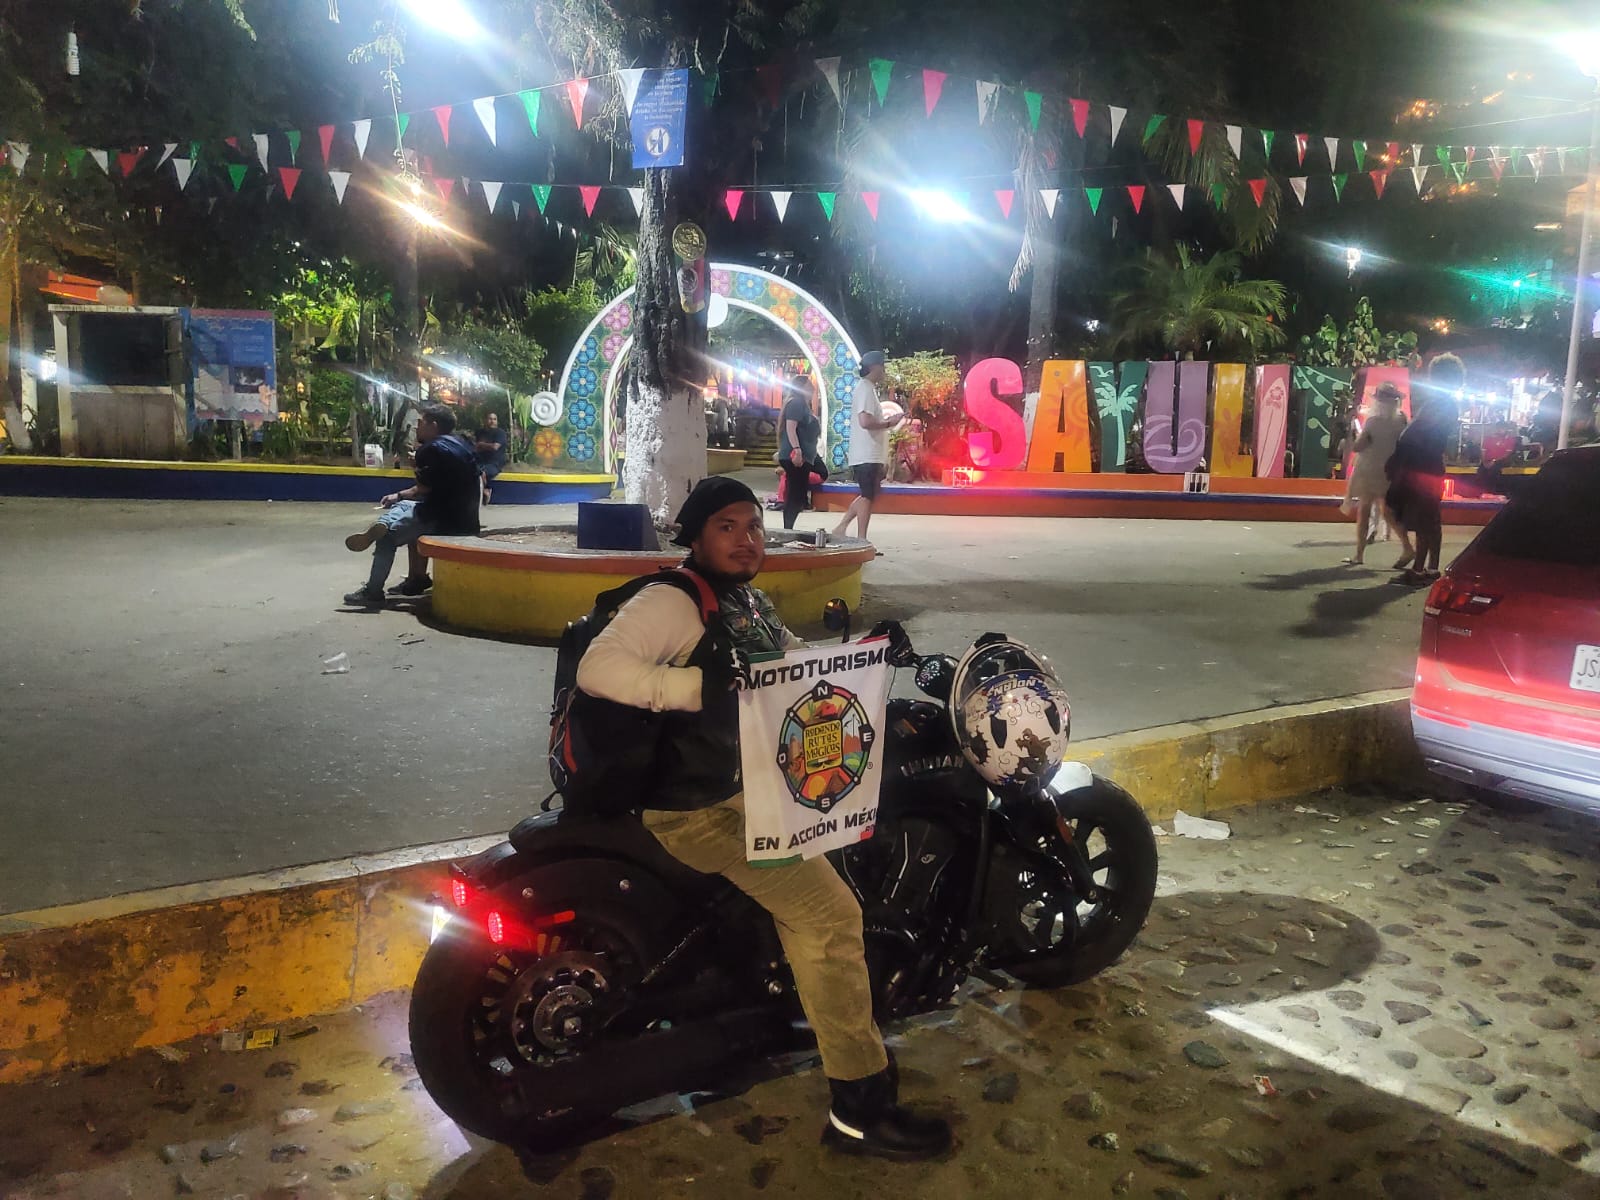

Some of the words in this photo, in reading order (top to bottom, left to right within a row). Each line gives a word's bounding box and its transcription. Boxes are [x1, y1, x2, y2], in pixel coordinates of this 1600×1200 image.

[743, 647, 890, 690] MOTOTURISM
[817, 685, 828, 697] N
[863, 732, 872, 742] E
[821, 797, 831, 808] S
[753, 836, 780, 851] EN
[787, 817, 837, 849] ACCIÓN
